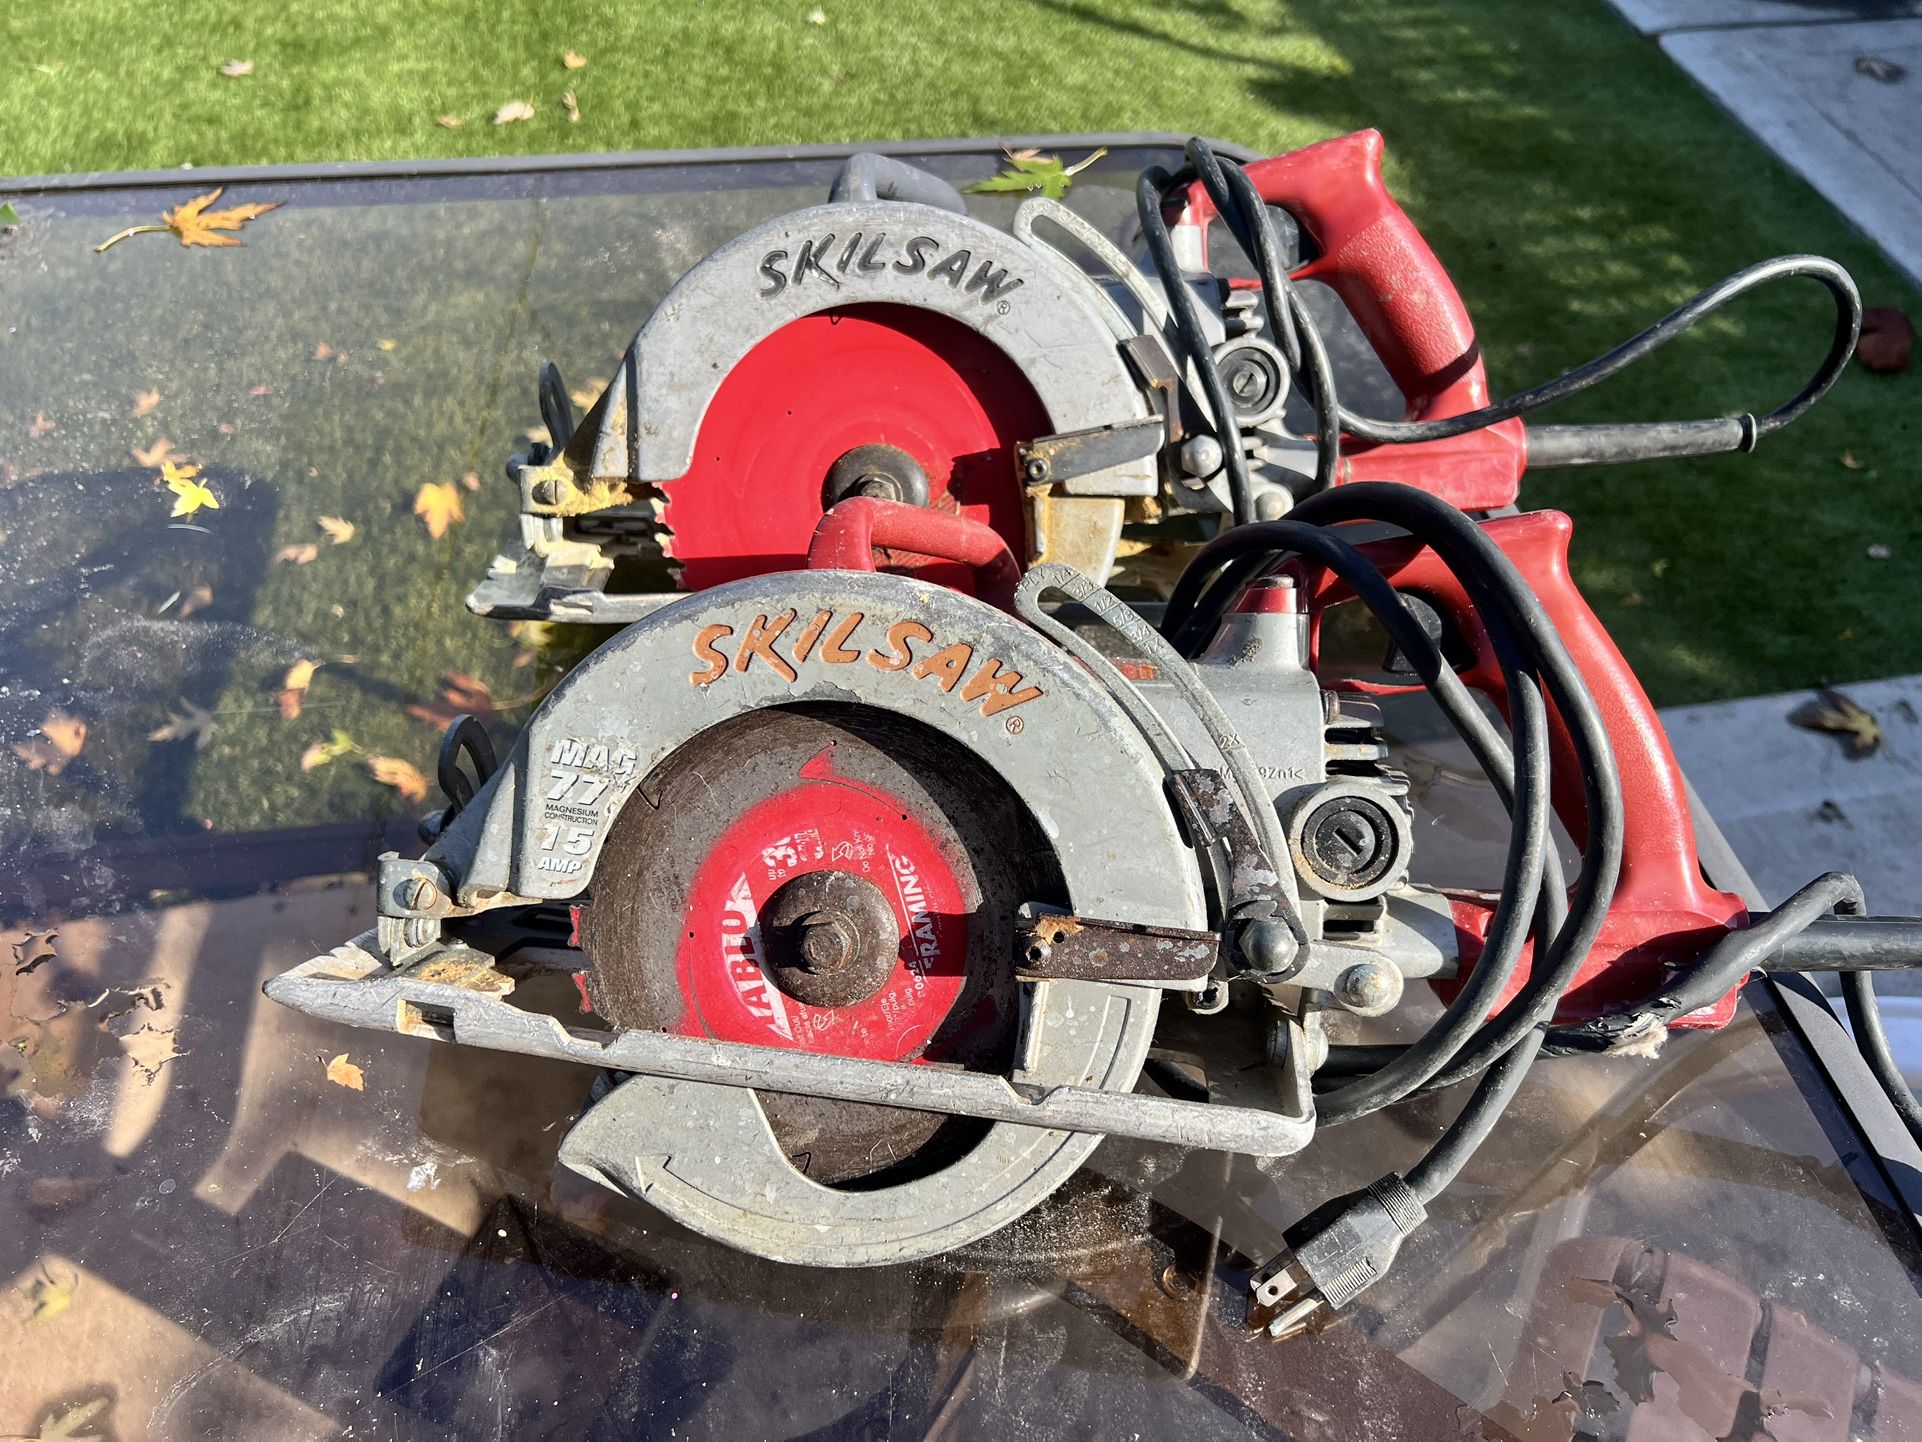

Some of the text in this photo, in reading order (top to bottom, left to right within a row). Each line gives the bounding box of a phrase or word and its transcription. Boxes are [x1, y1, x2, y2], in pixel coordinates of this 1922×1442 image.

[757, 232, 1024, 305] SKILSAW
[1021, 570, 1046, 592] PLY
[1094, 595, 1115, 611] 1/2
[1113, 605, 1134, 626] 5/8
[689, 608, 1044, 717] SKILSAW
[550, 738, 637, 776] MAG
[547, 769, 610, 806] 77
[544, 811, 598, 826] CONSTRUCTION
[545, 803, 599, 818] MAGNESIUM
[541, 823, 595, 856] 15
[538, 857, 582, 874] AMP
[894, 855, 941, 969] FRAMING
